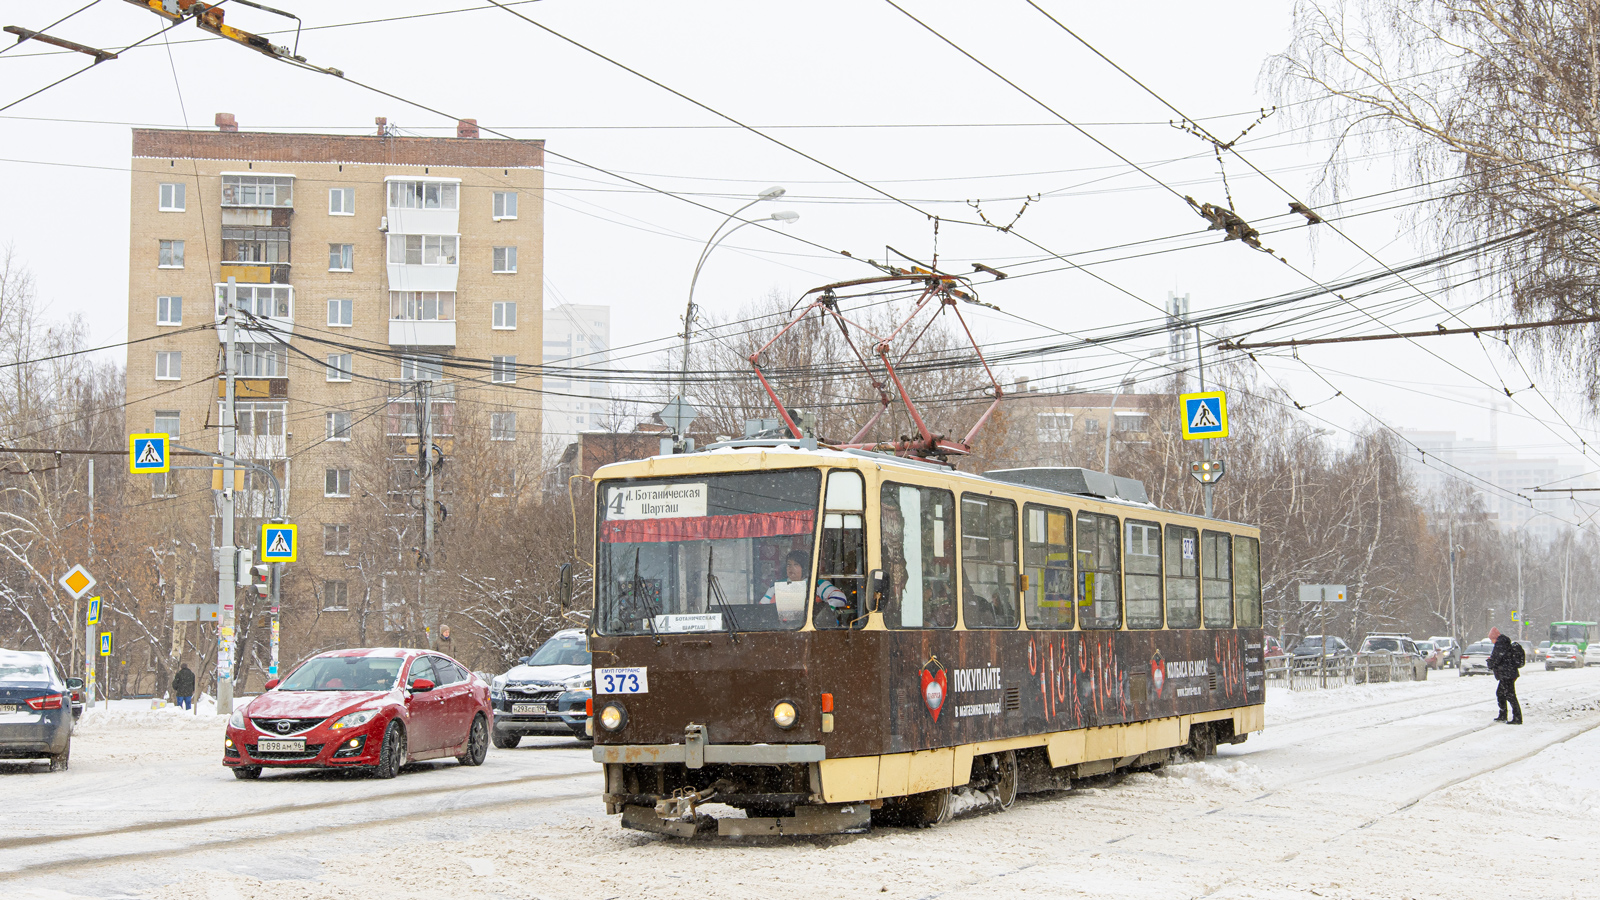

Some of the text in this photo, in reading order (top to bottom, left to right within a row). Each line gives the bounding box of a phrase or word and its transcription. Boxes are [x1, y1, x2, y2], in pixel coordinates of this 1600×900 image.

[635, 489, 701, 501] Ботаническая
[608, 492, 625, 515] 4
[641, 503, 679, 516] Шарташ
[1184, 540, 1193, 555] 373
[658, 615, 671, 631] 4
[603, 674, 640, 693] 373
[954, 662, 1001, 692] ПОКУПАЙТЕ
[954, 706, 959, 718] в
[959, 703, 984, 717] магазинах
